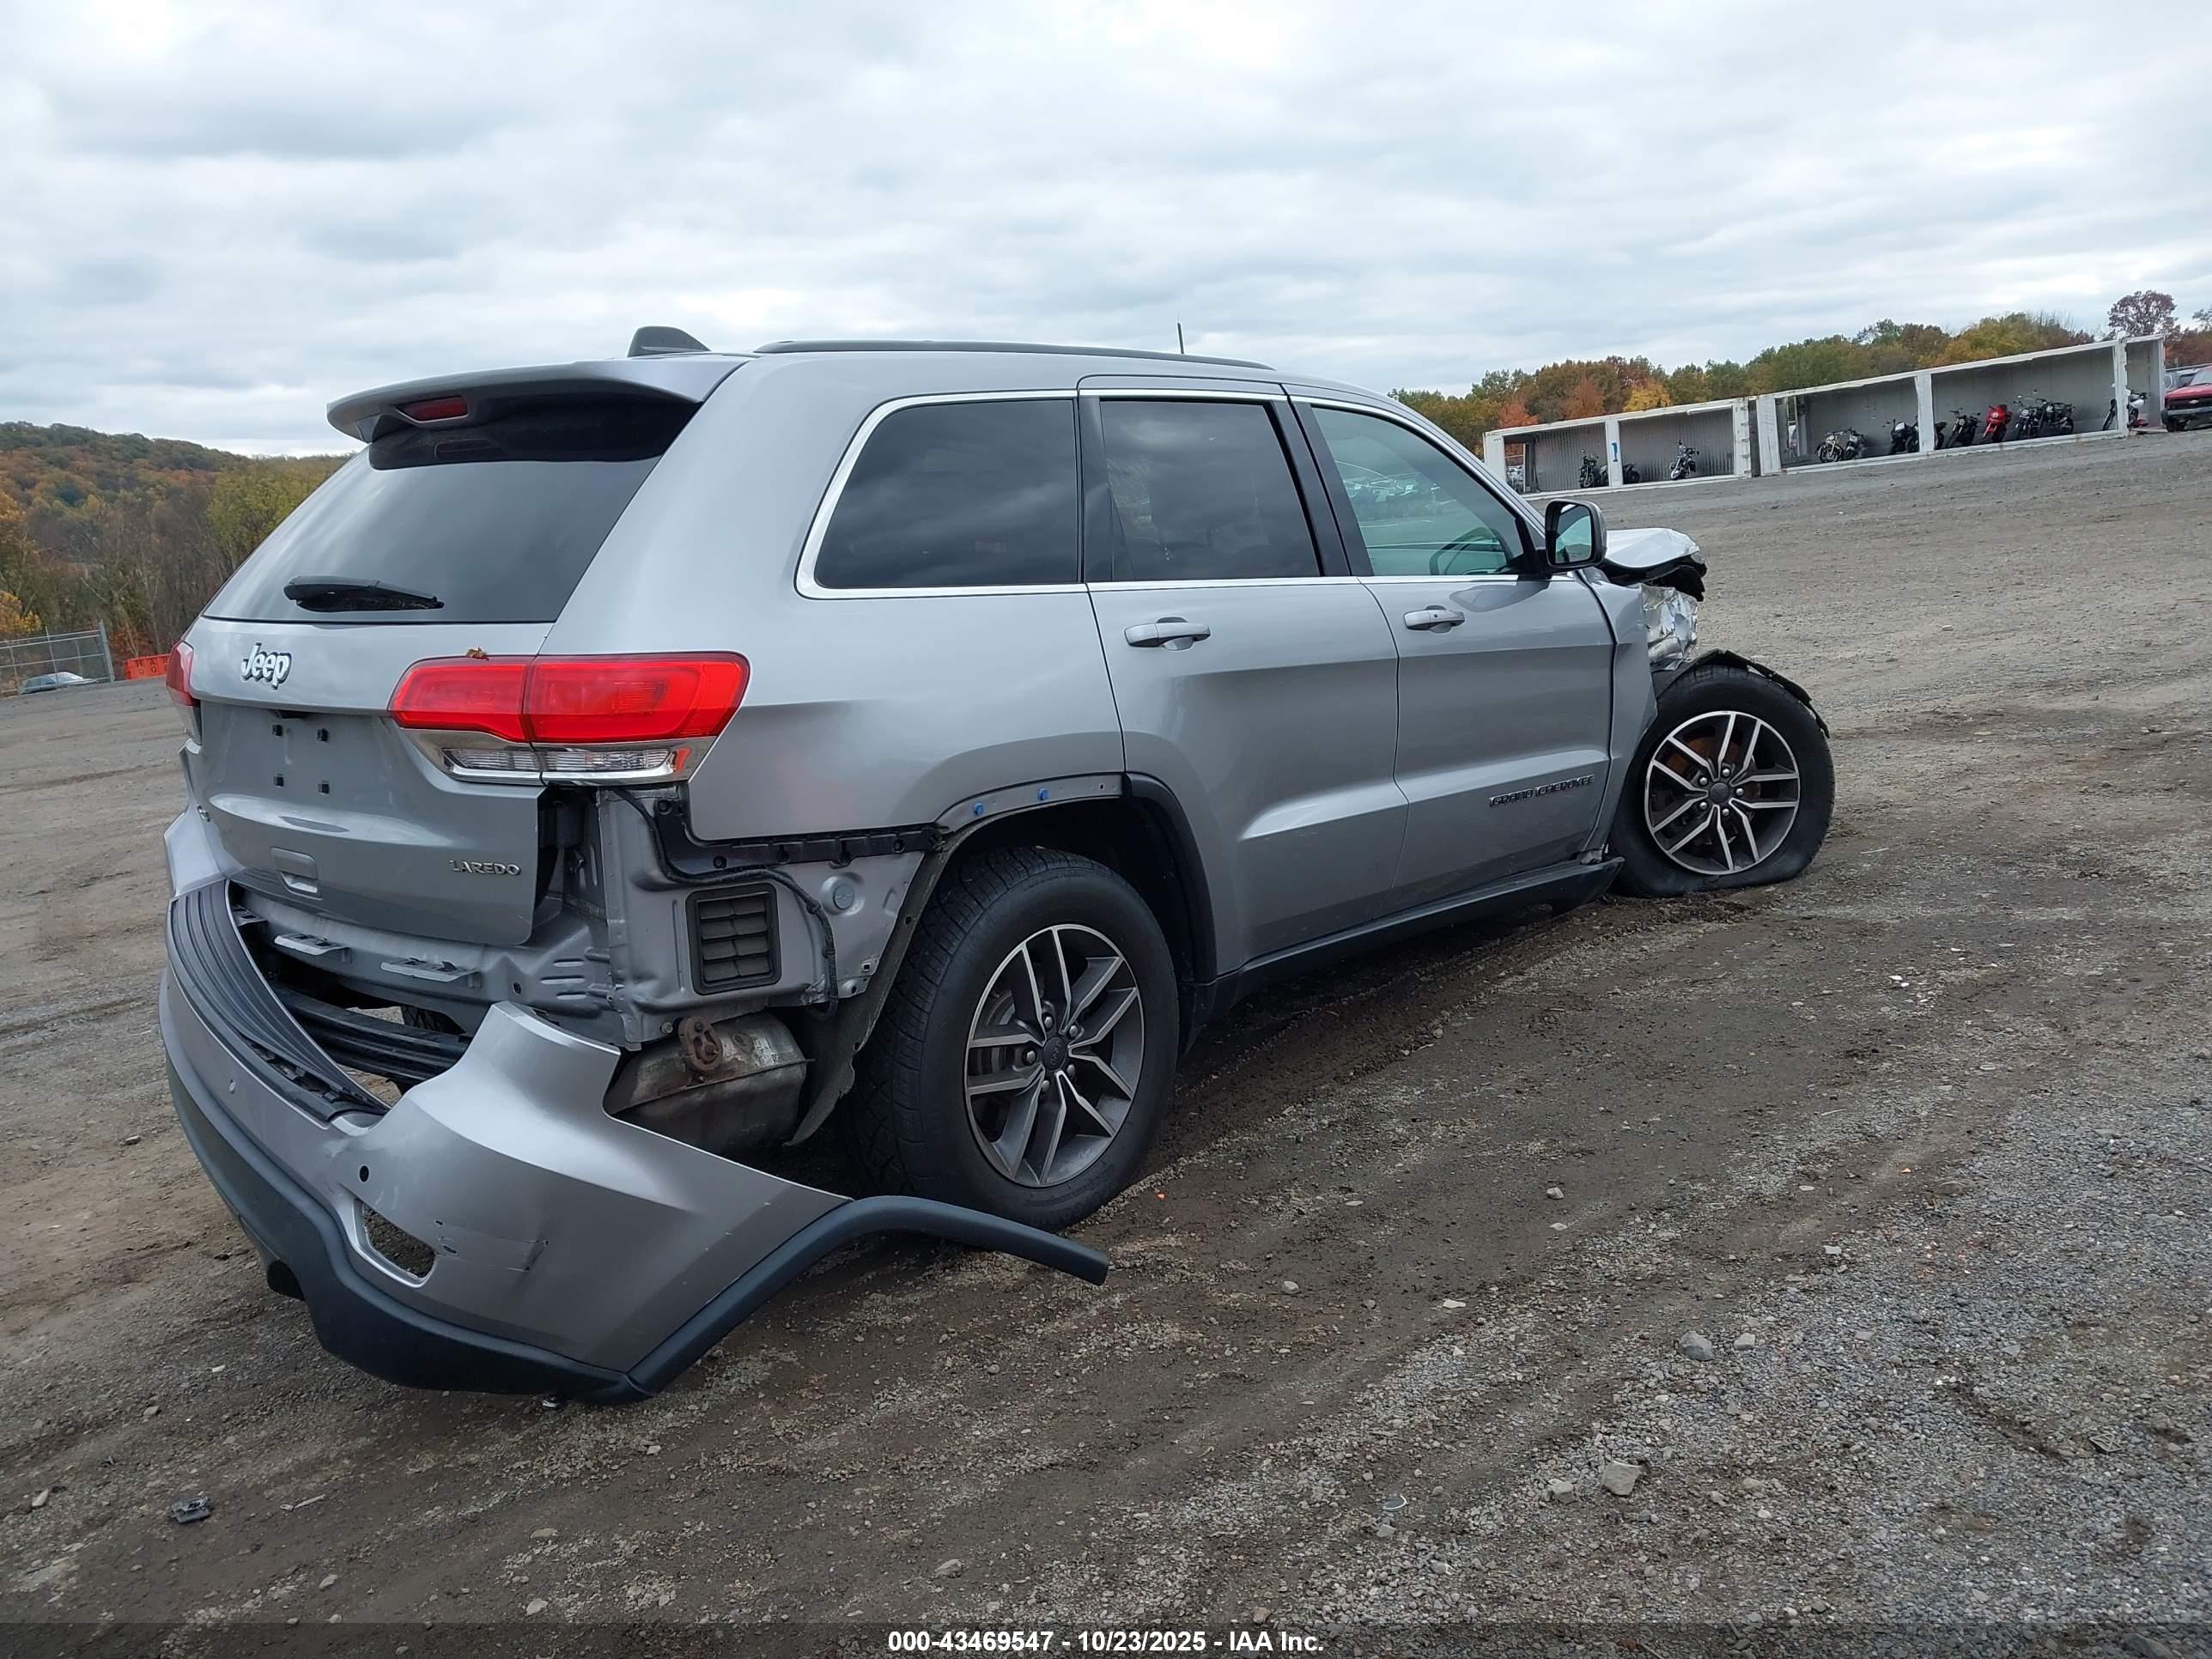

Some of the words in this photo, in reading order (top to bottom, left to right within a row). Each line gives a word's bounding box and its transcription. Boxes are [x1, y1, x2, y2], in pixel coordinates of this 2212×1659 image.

[240, 642, 292, 690] Jeep
[1489, 789, 1534, 806] GRAND
[1535, 775, 1595, 797] CHEROKEE
[449, 860, 521, 876] LAREDO
